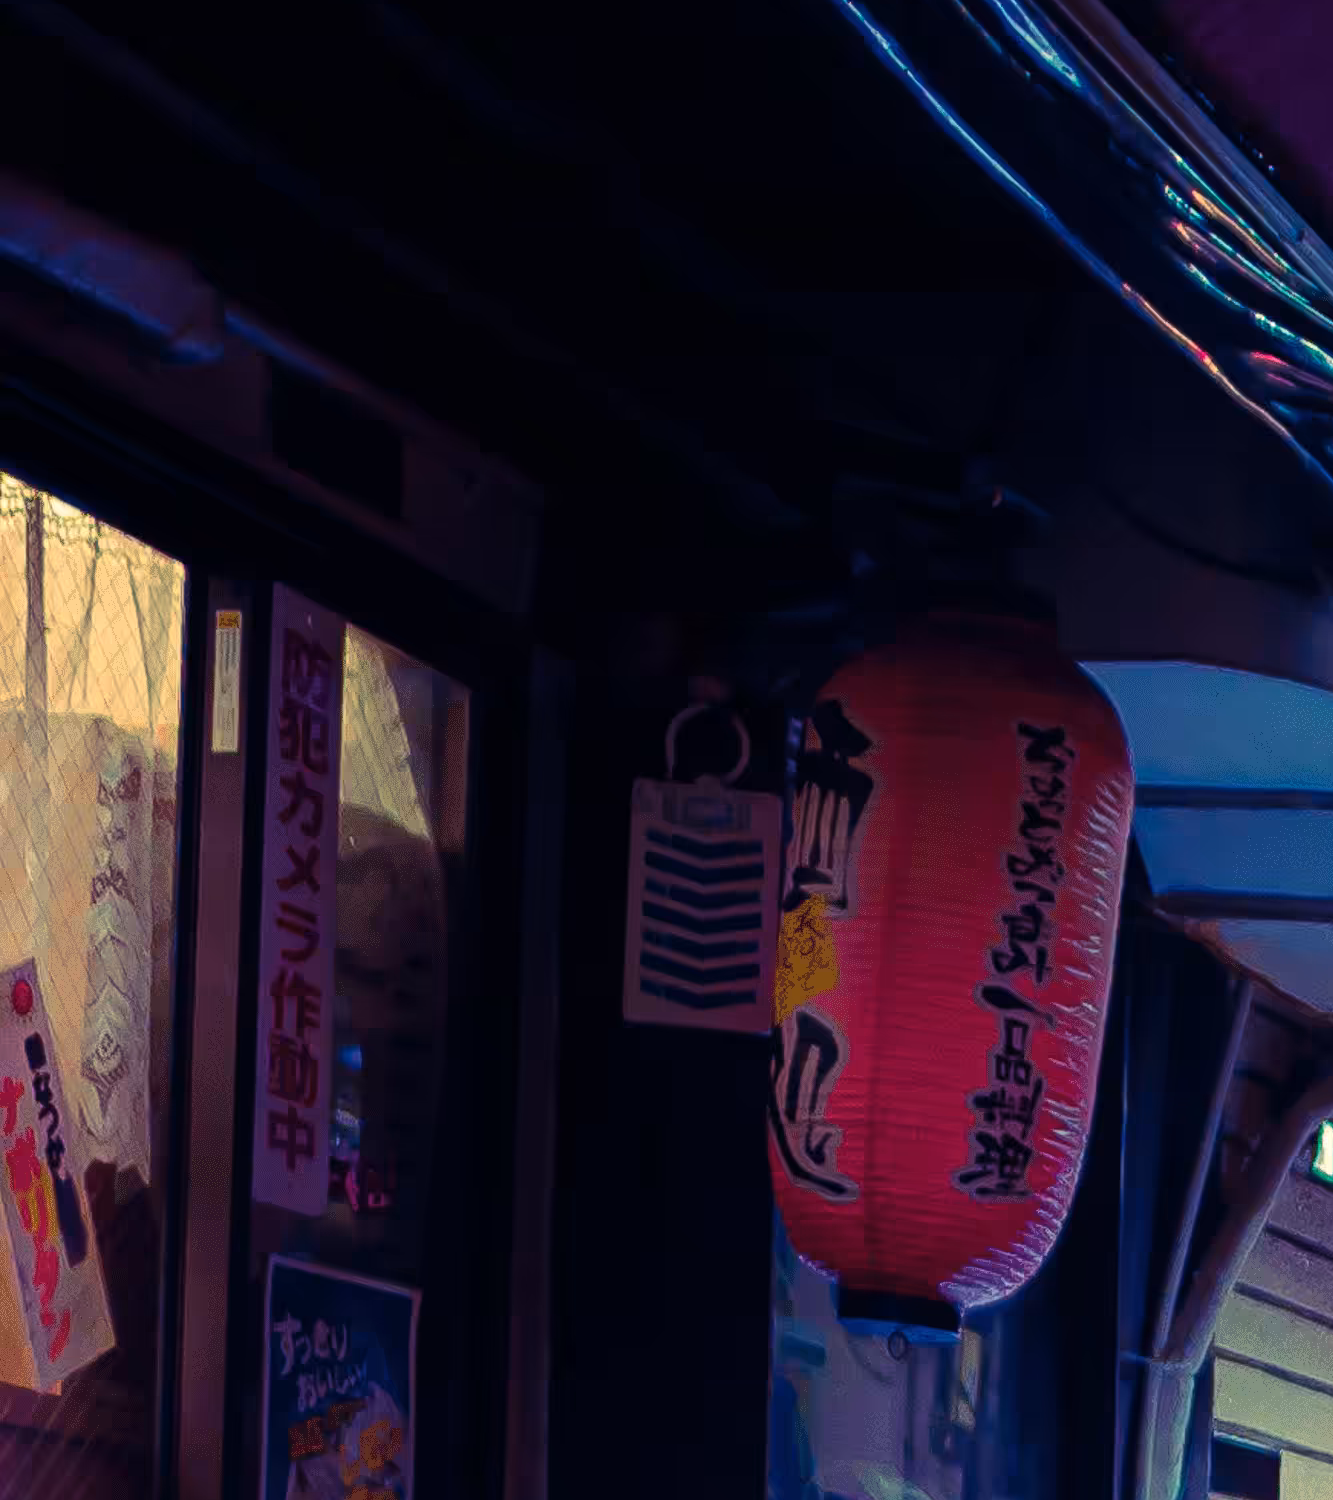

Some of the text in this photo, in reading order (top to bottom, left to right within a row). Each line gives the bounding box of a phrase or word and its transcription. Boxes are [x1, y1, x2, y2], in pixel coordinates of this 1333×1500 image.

[268, 626, 332, 1174] 防犯カメラ作動中
